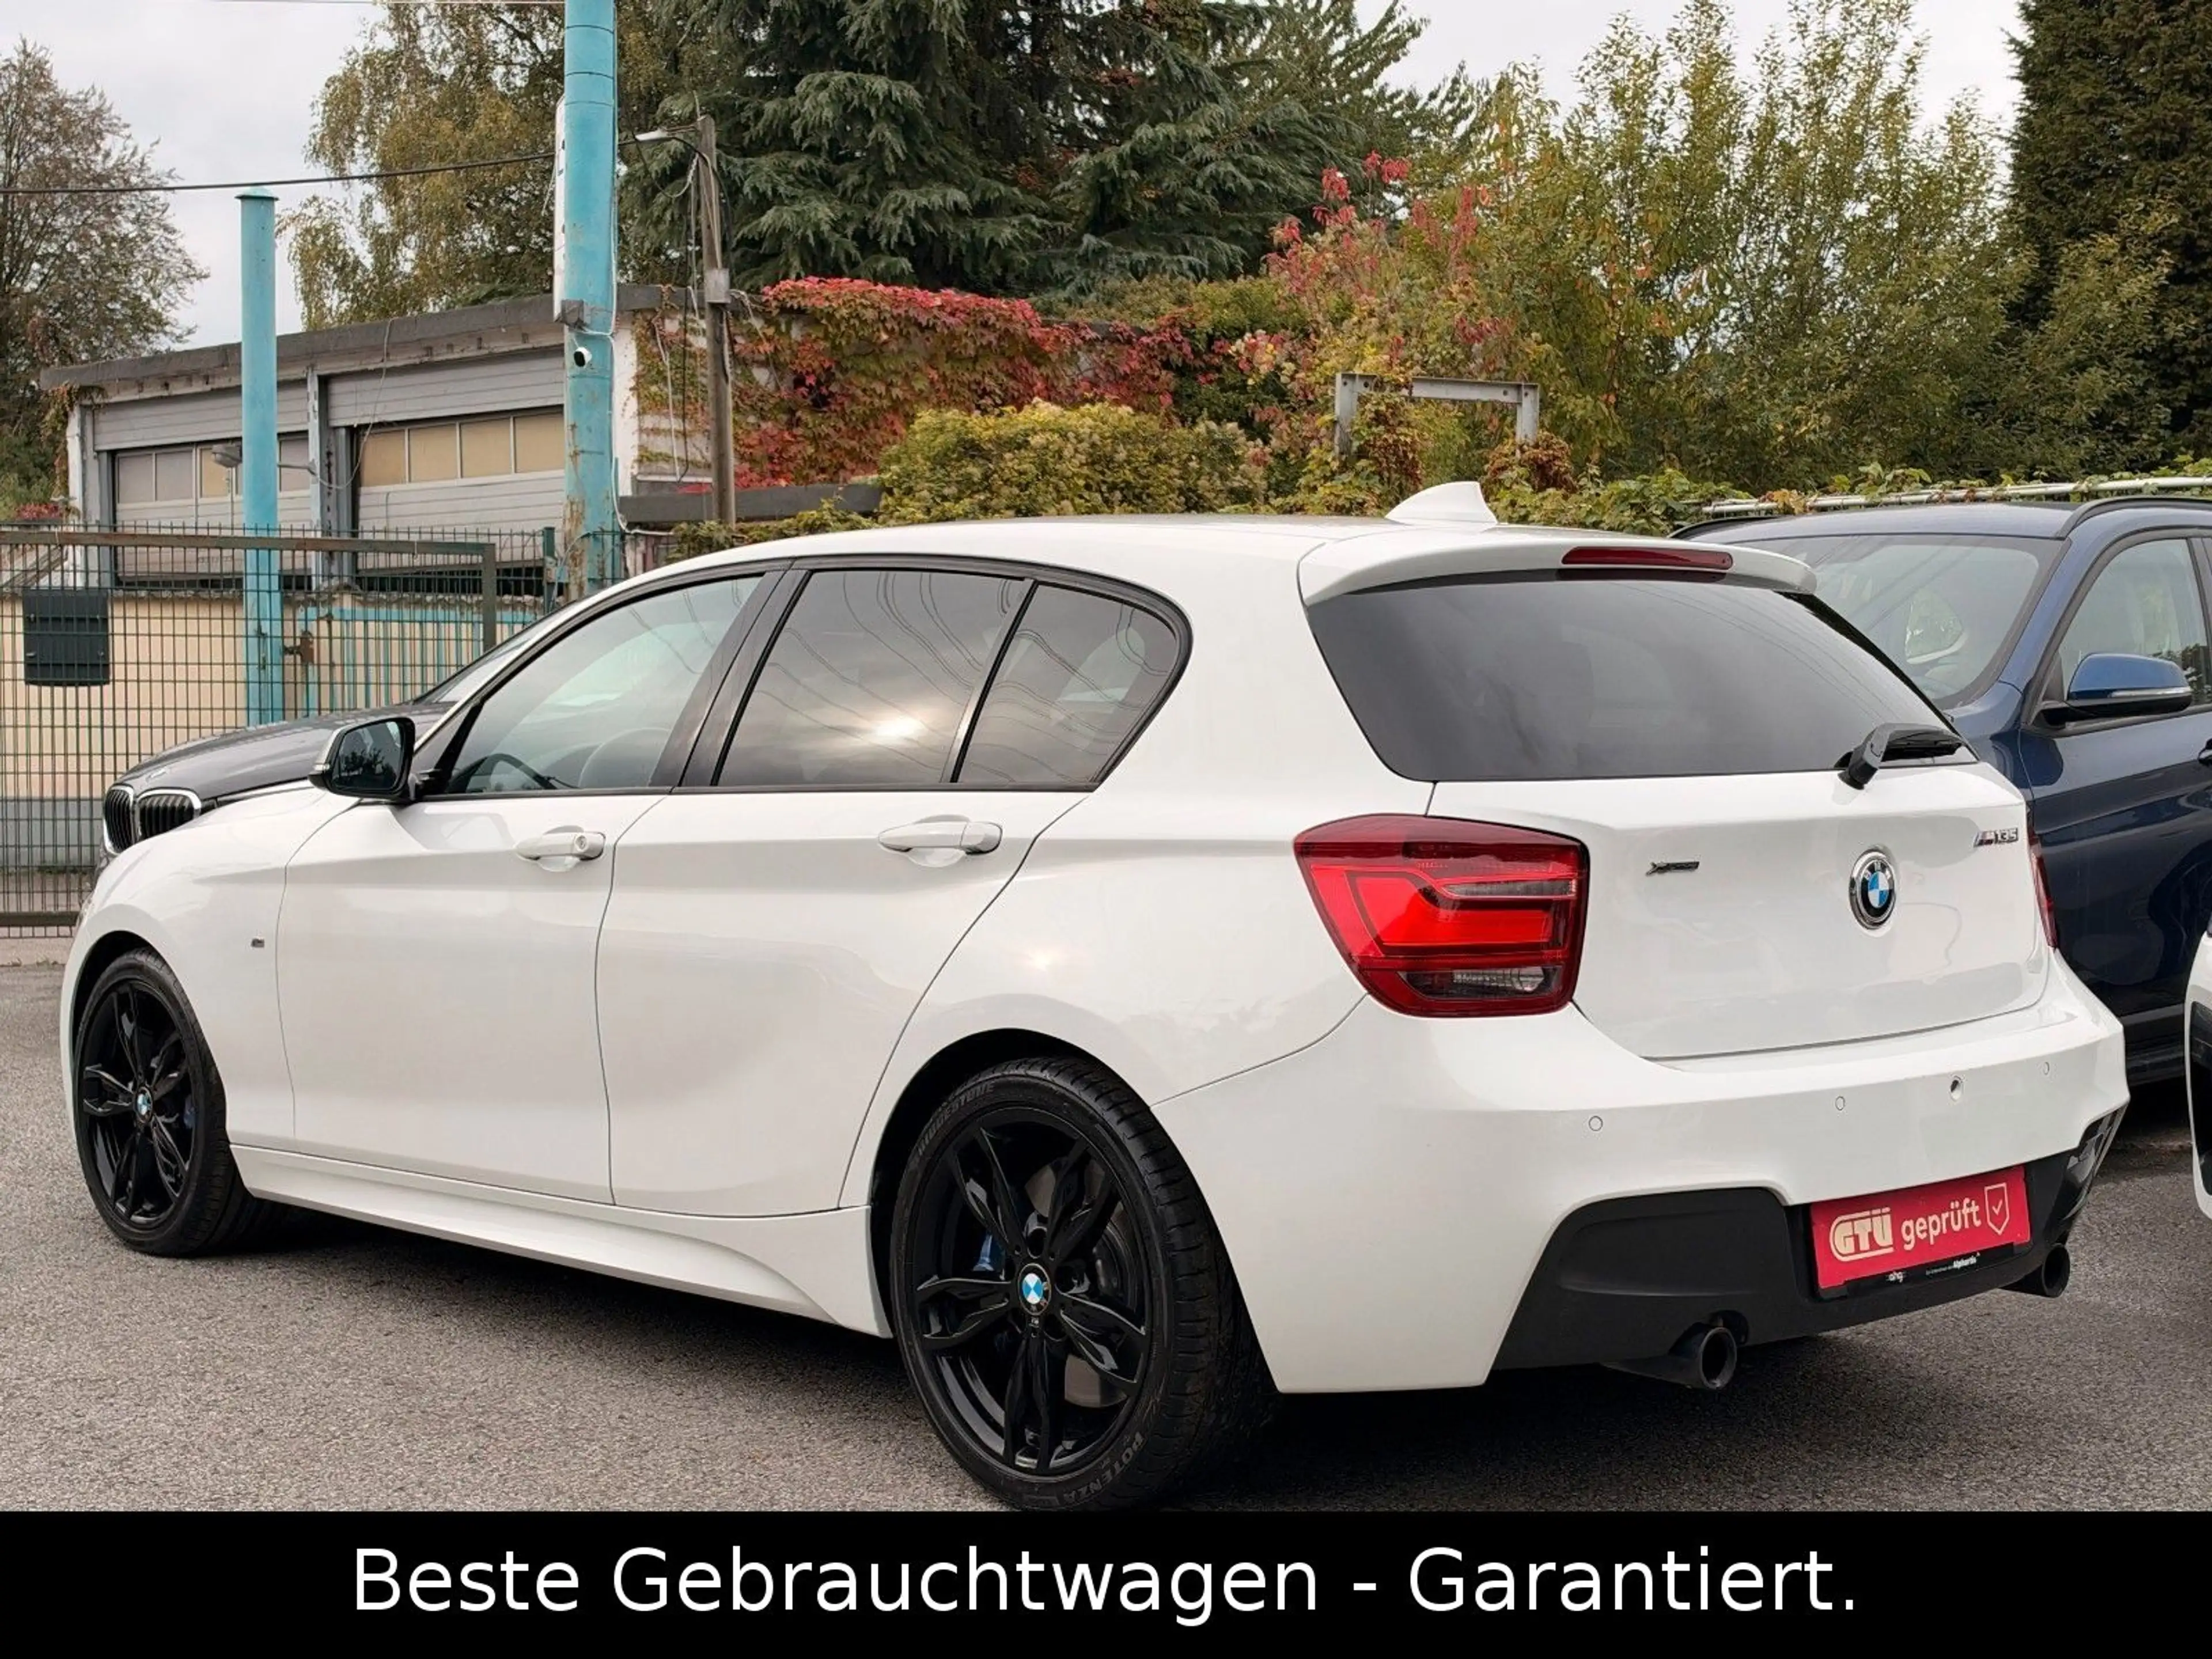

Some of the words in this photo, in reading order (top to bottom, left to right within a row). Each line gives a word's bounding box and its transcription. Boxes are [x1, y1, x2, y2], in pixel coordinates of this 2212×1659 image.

[1832, 1207, 1894, 1258] GTÜ
[1901, 1198, 1982, 1250] geprüft
[1063, 1430, 1147, 1504] POTENZA
